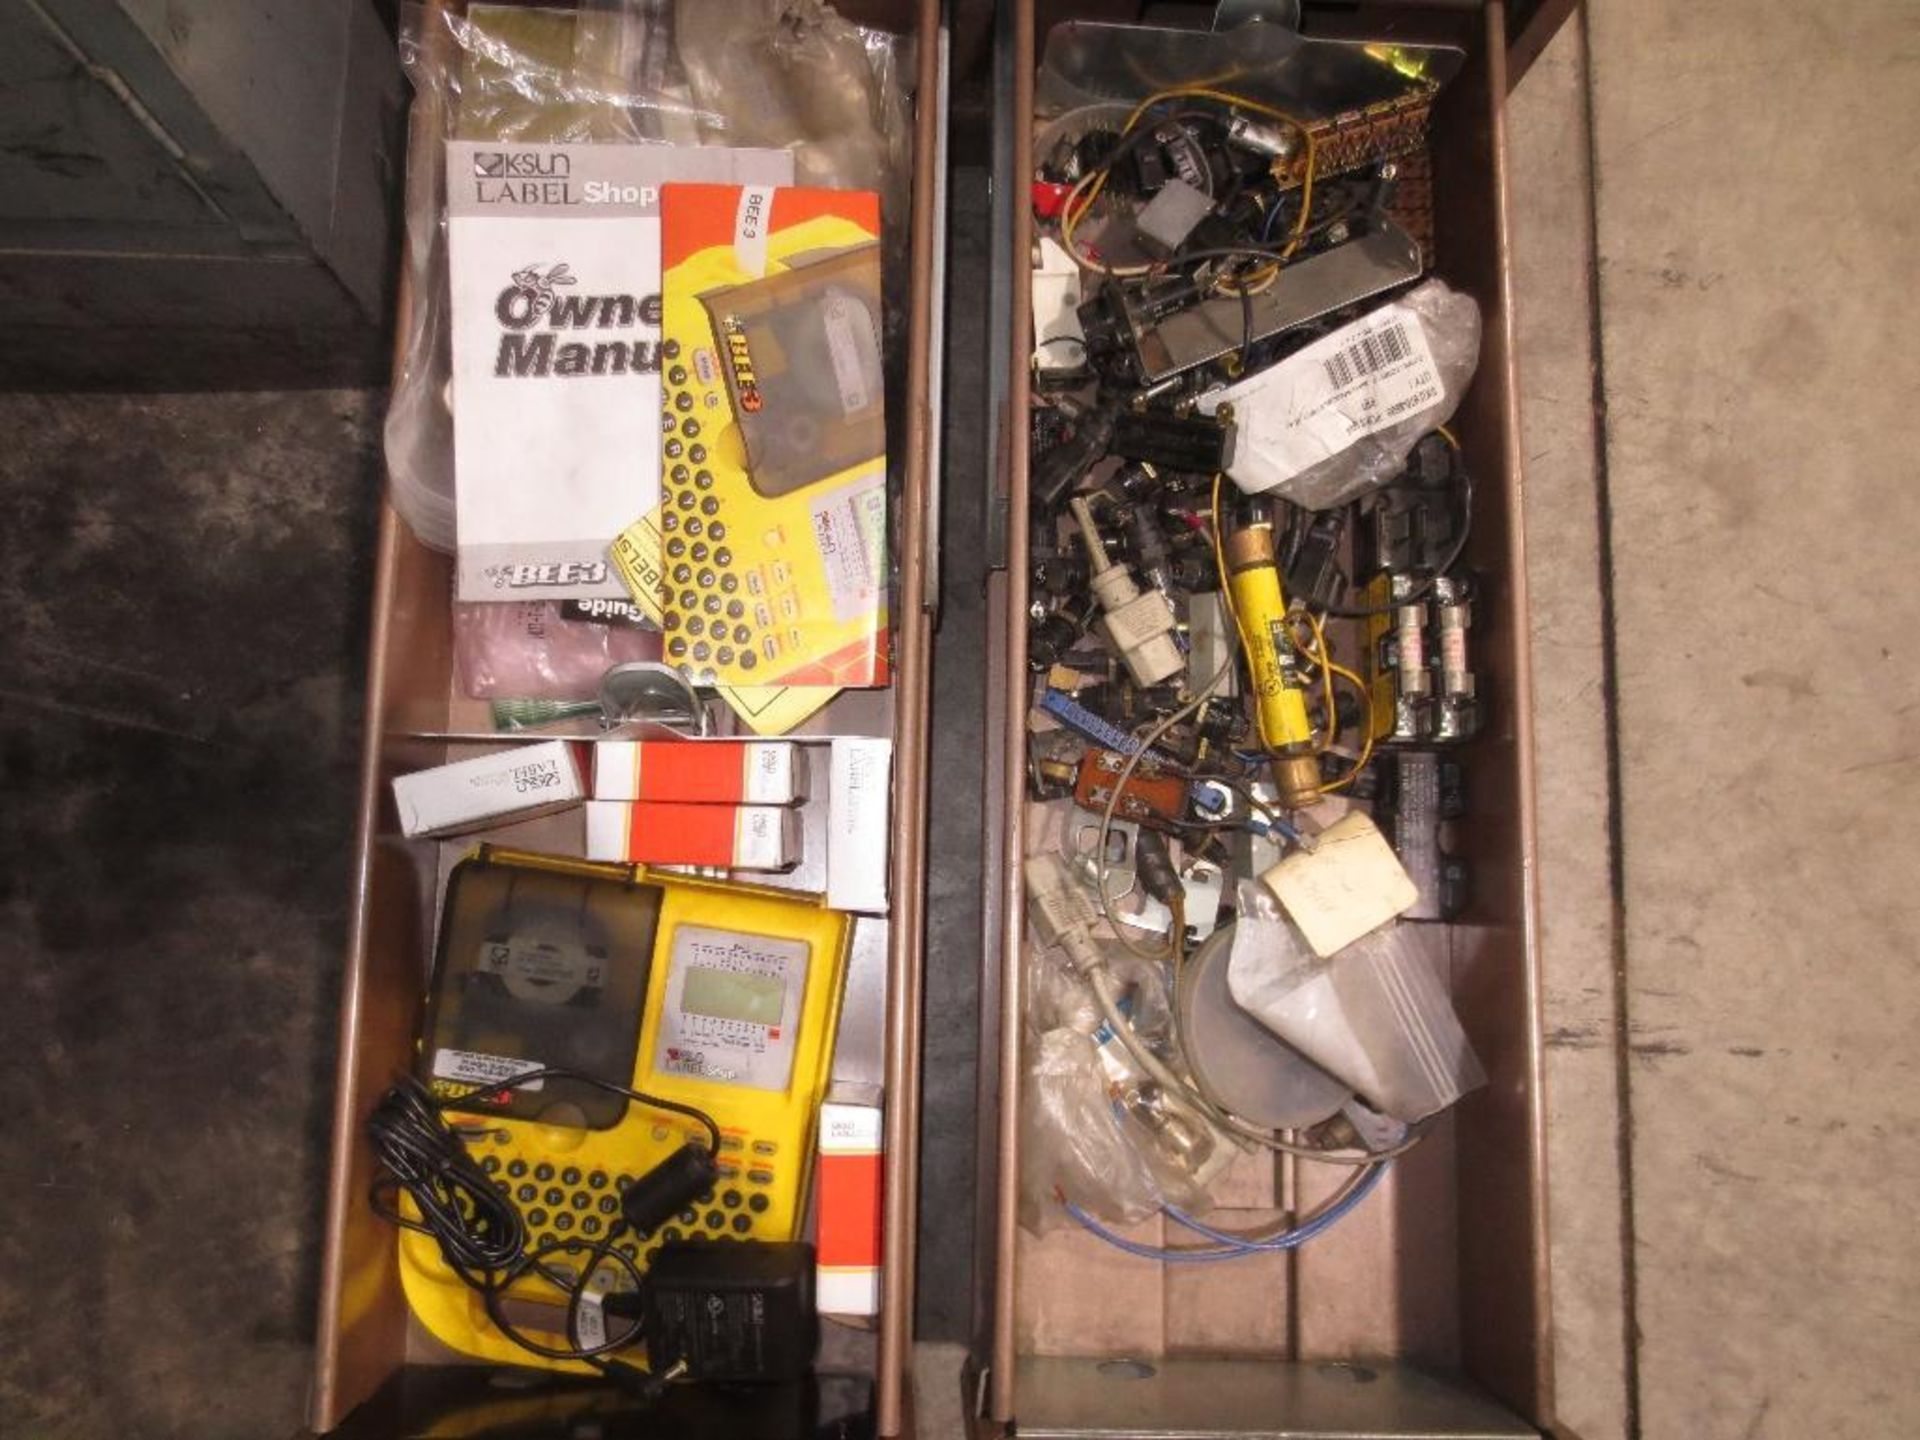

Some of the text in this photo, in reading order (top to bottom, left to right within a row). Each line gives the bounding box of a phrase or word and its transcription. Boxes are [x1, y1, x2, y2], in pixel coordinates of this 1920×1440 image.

[476, 181, 658, 207] LABEL Shop
[745, 194, 764, 226] BEE
[578, 598, 646, 622] Guide
